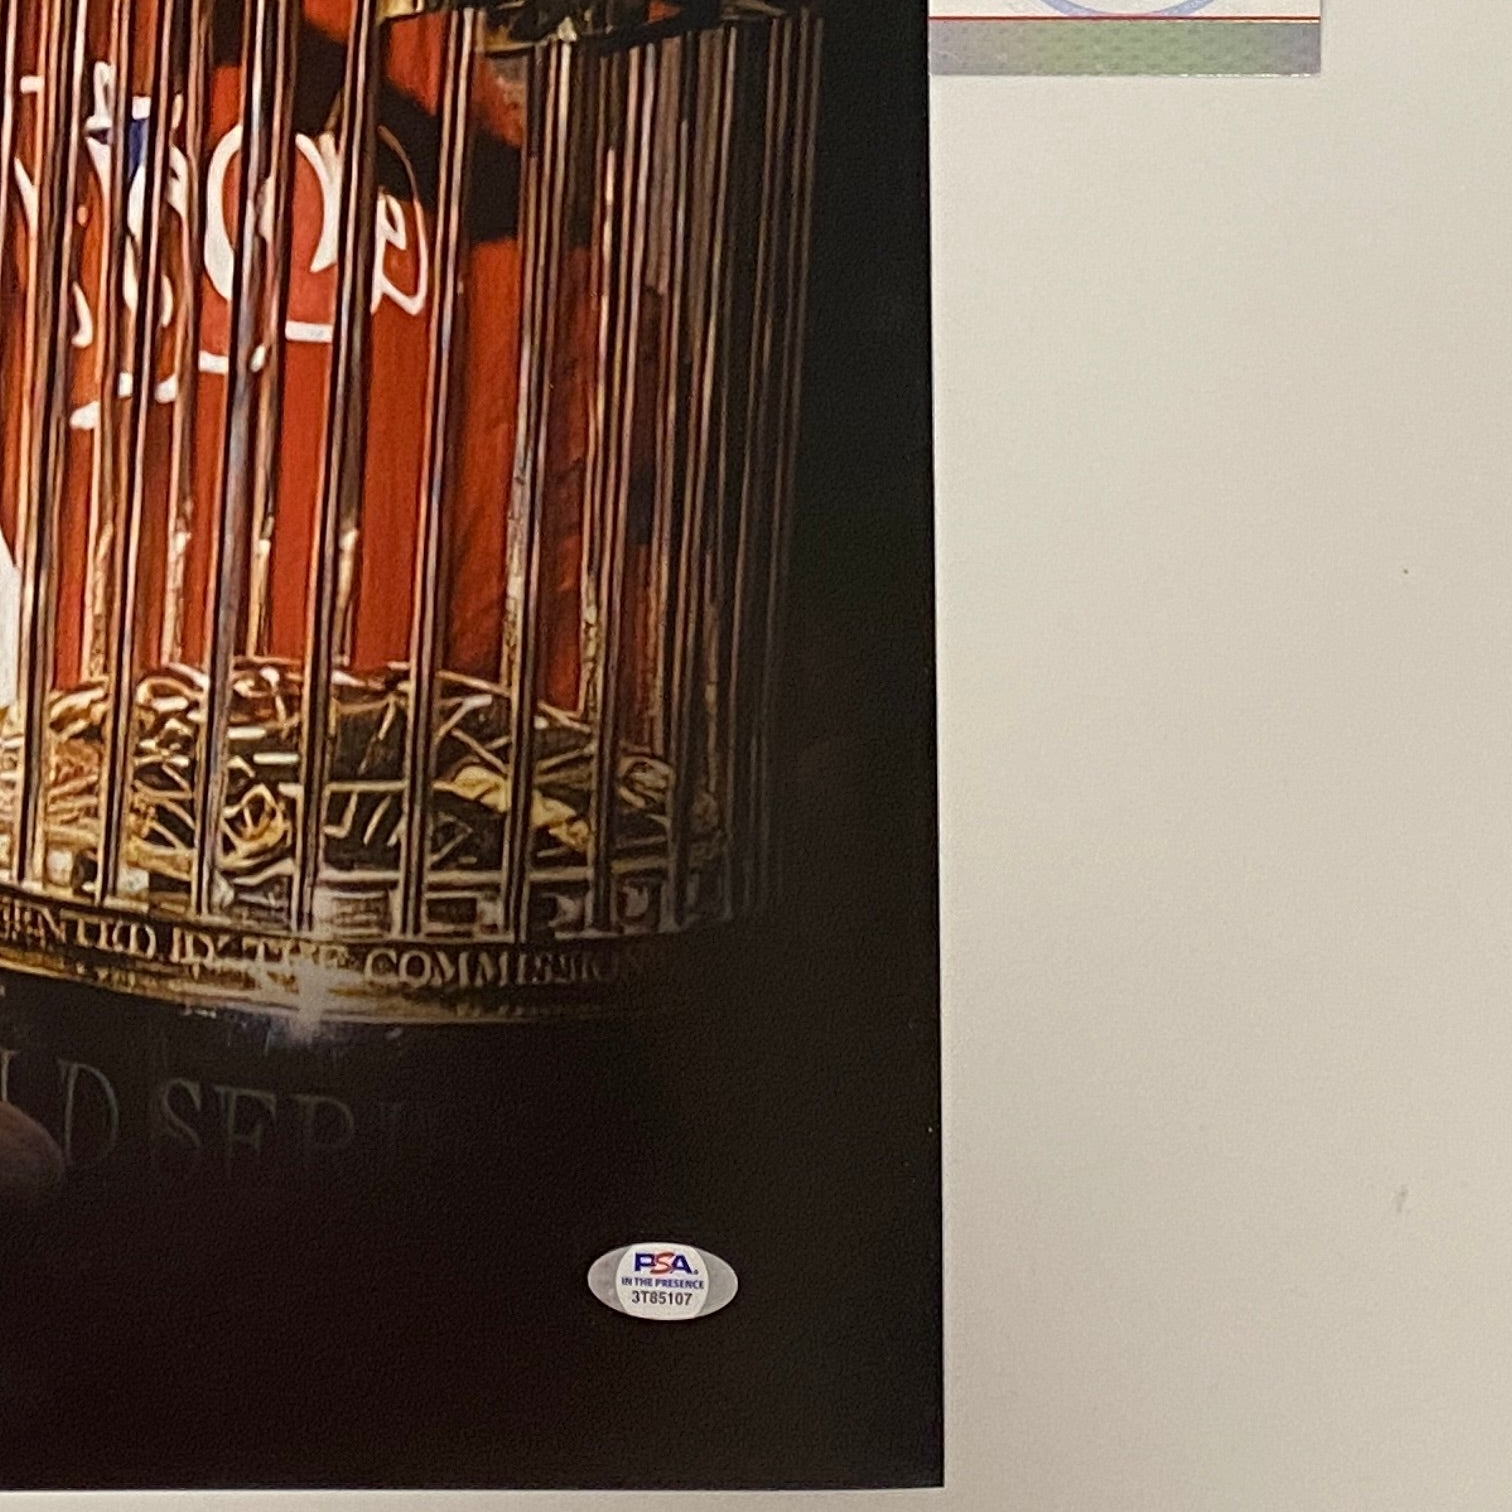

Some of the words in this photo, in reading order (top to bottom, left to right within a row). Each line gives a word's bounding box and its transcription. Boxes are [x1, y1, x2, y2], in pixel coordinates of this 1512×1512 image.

[634, 1252, 693, 1275] PSA
[622, 1277, 633, 1286] IN
[635, 1278, 652, 1287] THE
[655, 1278, 704, 1289] PRESENCE
[632, 1291, 692, 1306] 3T85107
